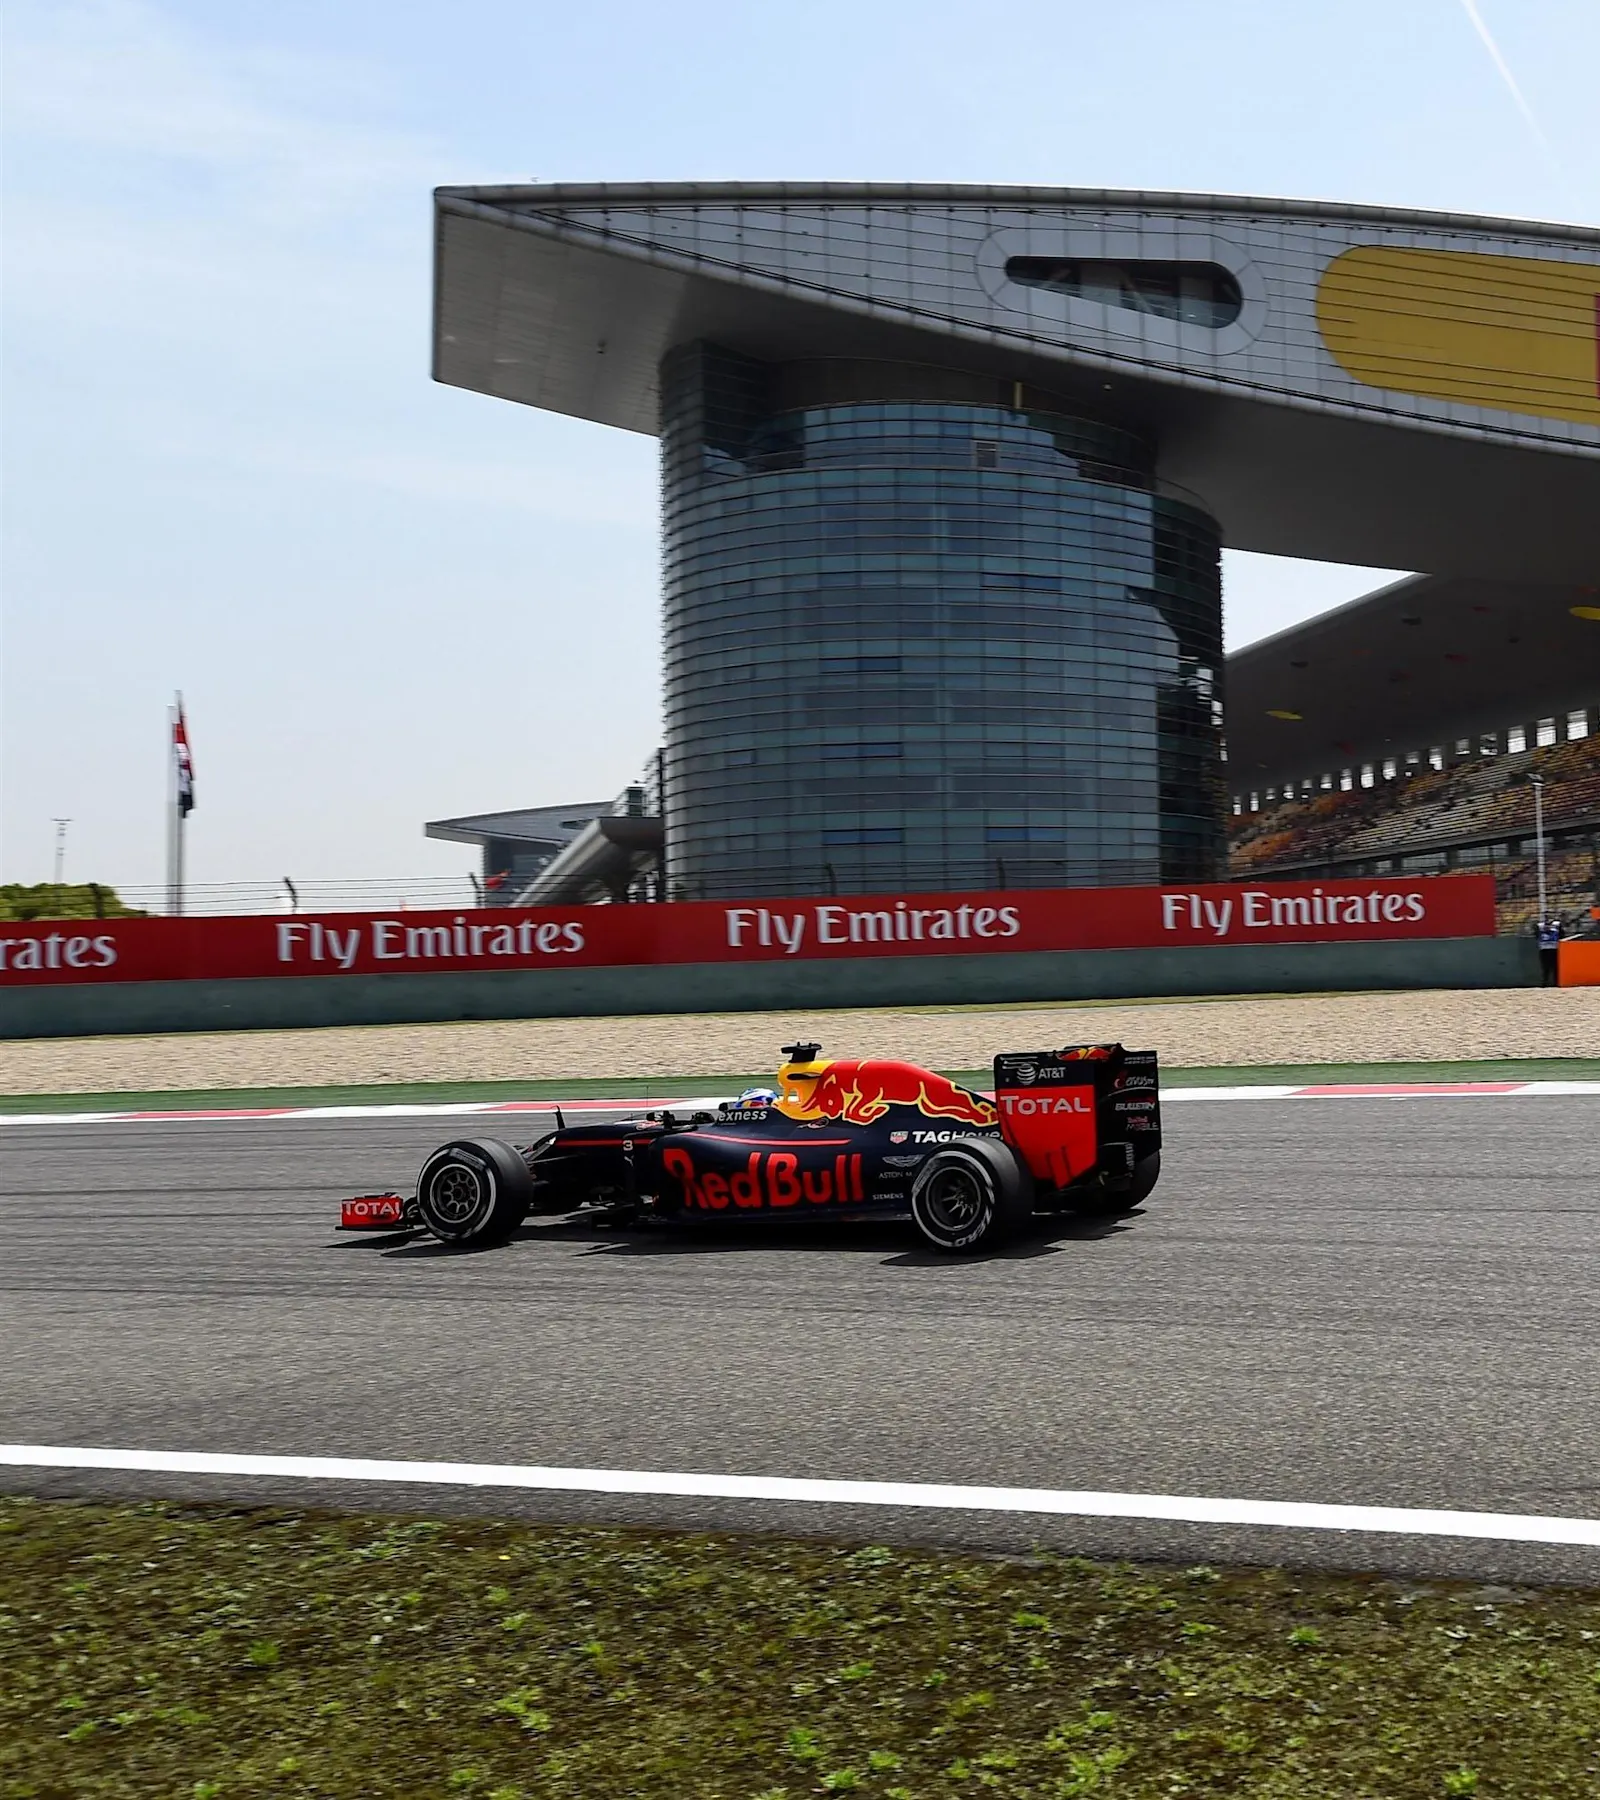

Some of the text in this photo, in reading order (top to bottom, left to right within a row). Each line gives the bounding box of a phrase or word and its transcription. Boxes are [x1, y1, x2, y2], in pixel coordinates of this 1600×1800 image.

[724, 902, 1021, 955] Fly Emirates
[1160, 890, 1425, 937] Fly Emirates
[275, 917, 585, 970] Fly Emirates
[1038, 1066, 1067, 1079] AT&T
[718, 1109, 768, 1122] exness
[1000, 1095, 1092, 1116] TOTAL
[622, 1139, 634, 1151] 3
[663, 1148, 763, 1209] Red
[766, 1152, 864, 1207] Bull
